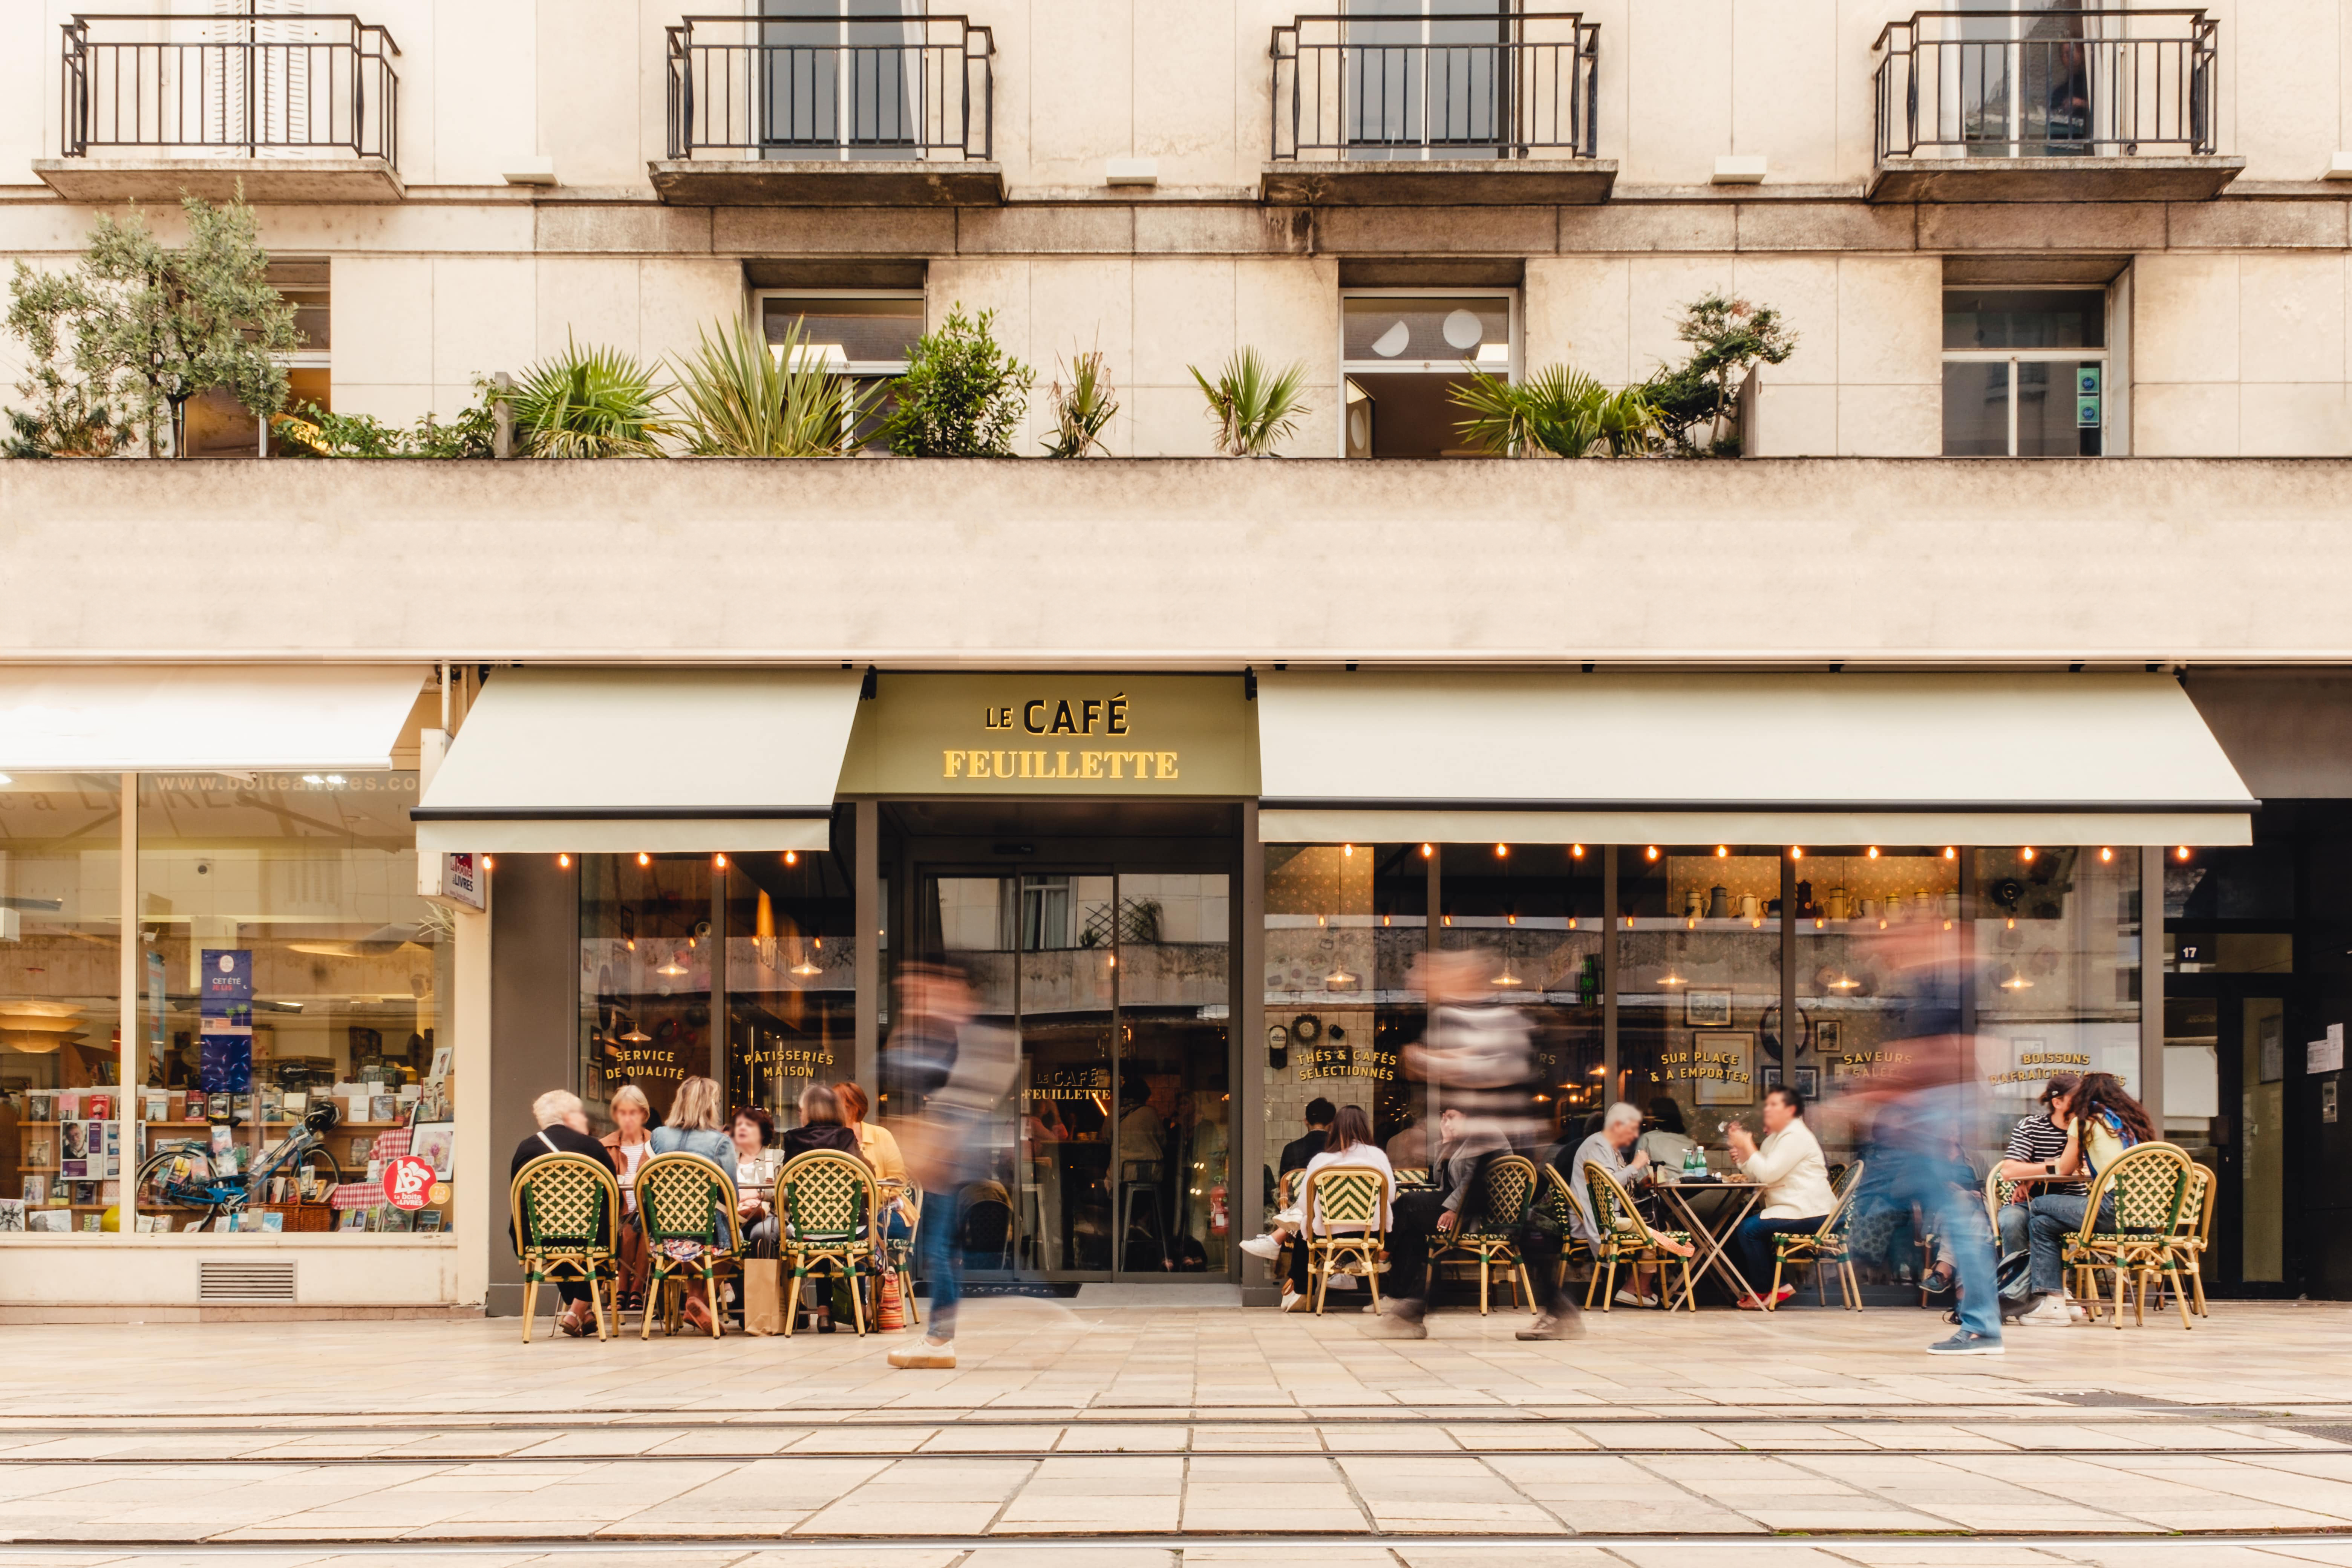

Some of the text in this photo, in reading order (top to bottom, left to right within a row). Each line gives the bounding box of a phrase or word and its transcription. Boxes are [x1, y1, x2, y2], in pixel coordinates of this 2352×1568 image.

[985, 691, 1130, 736] LE CAFÉ
[943, 750, 1179, 779] FEUILLETTE
[2183, 947, 2197, 957] 17
[616, 1050, 675, 1062] SERVICE
[744, 1050, 835, 1065] PÂTISSERIES
[1296, 1049, 1332, 1065] THÉS
[1338, 1050, 1346, 1060] &
[1353, 1050, 1397, 1066] CAFÉS
[1661, 1052, 1739, 1065] SUR PLACE
[1844, 1051, 1913, 1065] SAVEURS
[2023, 1052, 2090, 1065] BOISSONS
[606, 1066, 684, 1080] DE QUALITÉ
[763, 1066, 815, 1078] MAISON
[1036, 1068, 1099, 1087] LE CAFÉ
[1299, 1065, 1394, 1081] SELECTIONNÉS
[1650, 1067, 1749, 1084] & À EMPORTER
[1853, 1066, 1900, 1079] SALÉE
[1023, 1089, 1110, 1100] FEUILLETTE
